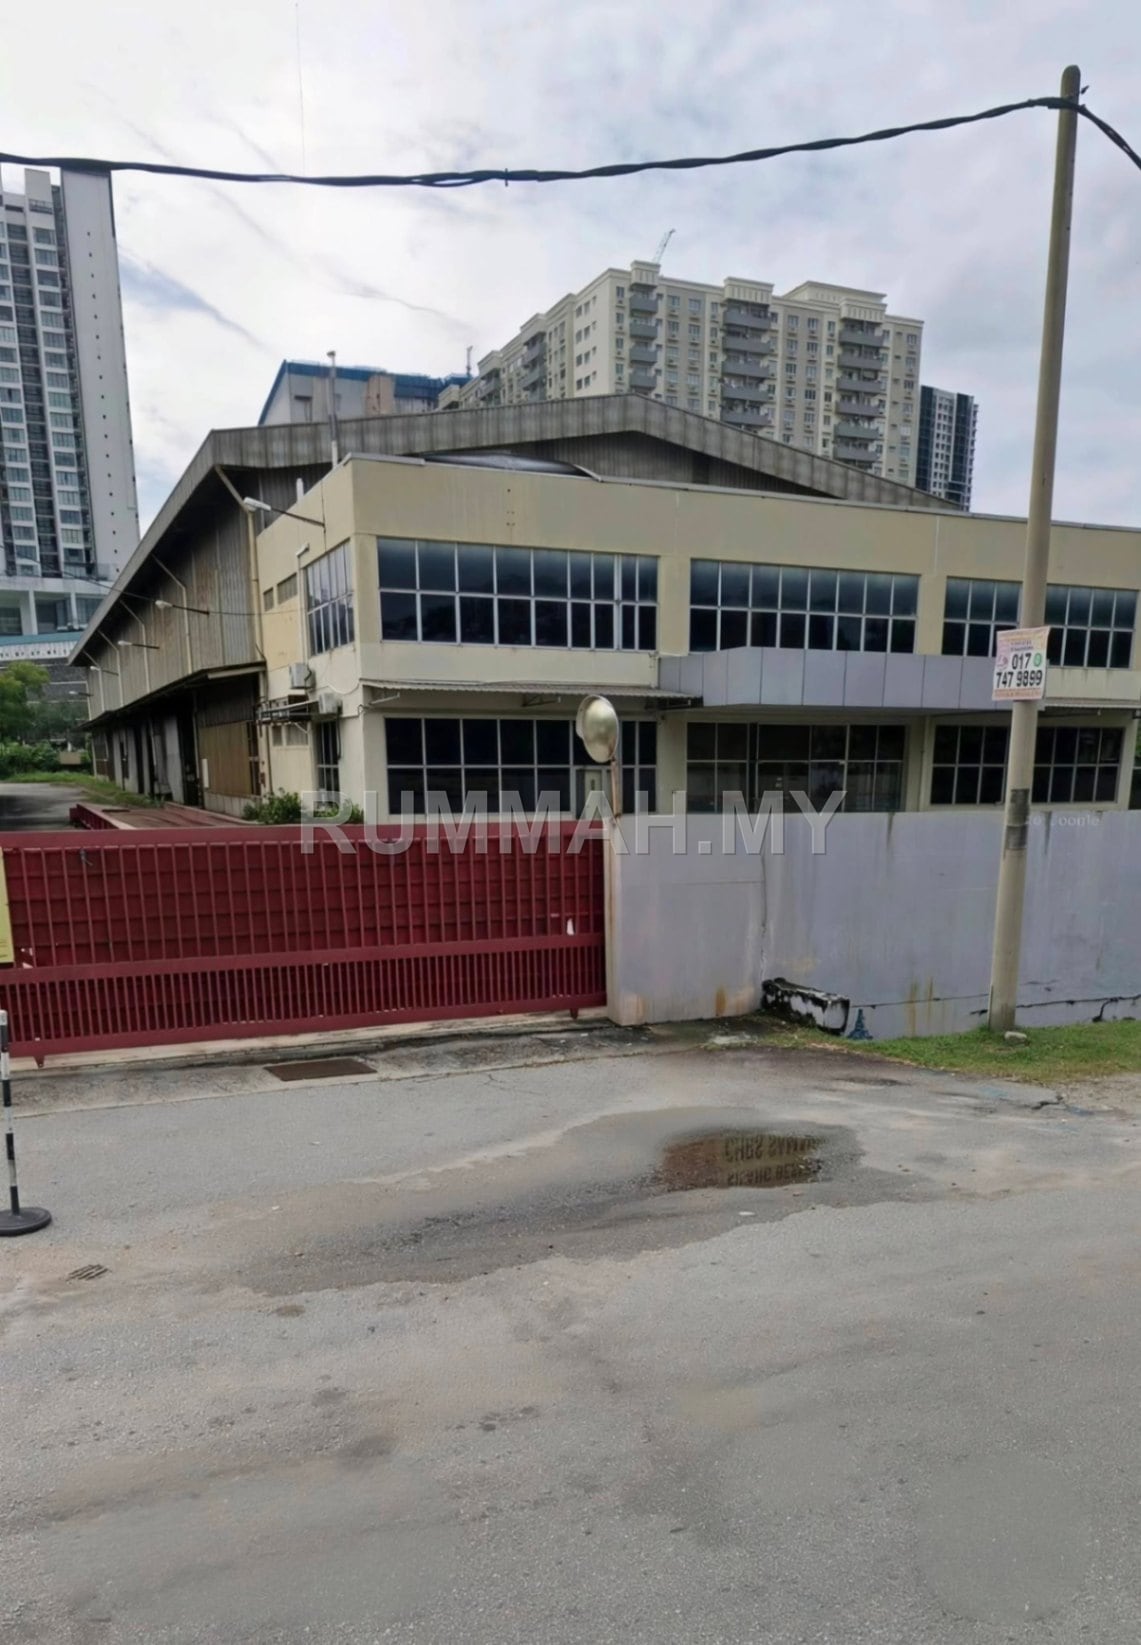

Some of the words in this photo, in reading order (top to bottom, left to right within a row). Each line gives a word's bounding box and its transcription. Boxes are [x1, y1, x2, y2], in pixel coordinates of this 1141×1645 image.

[1012, 653, 1032, 670] 017
[996, 672, 1013, 688] 747
[1017, 670, 1042, 687] 9899
